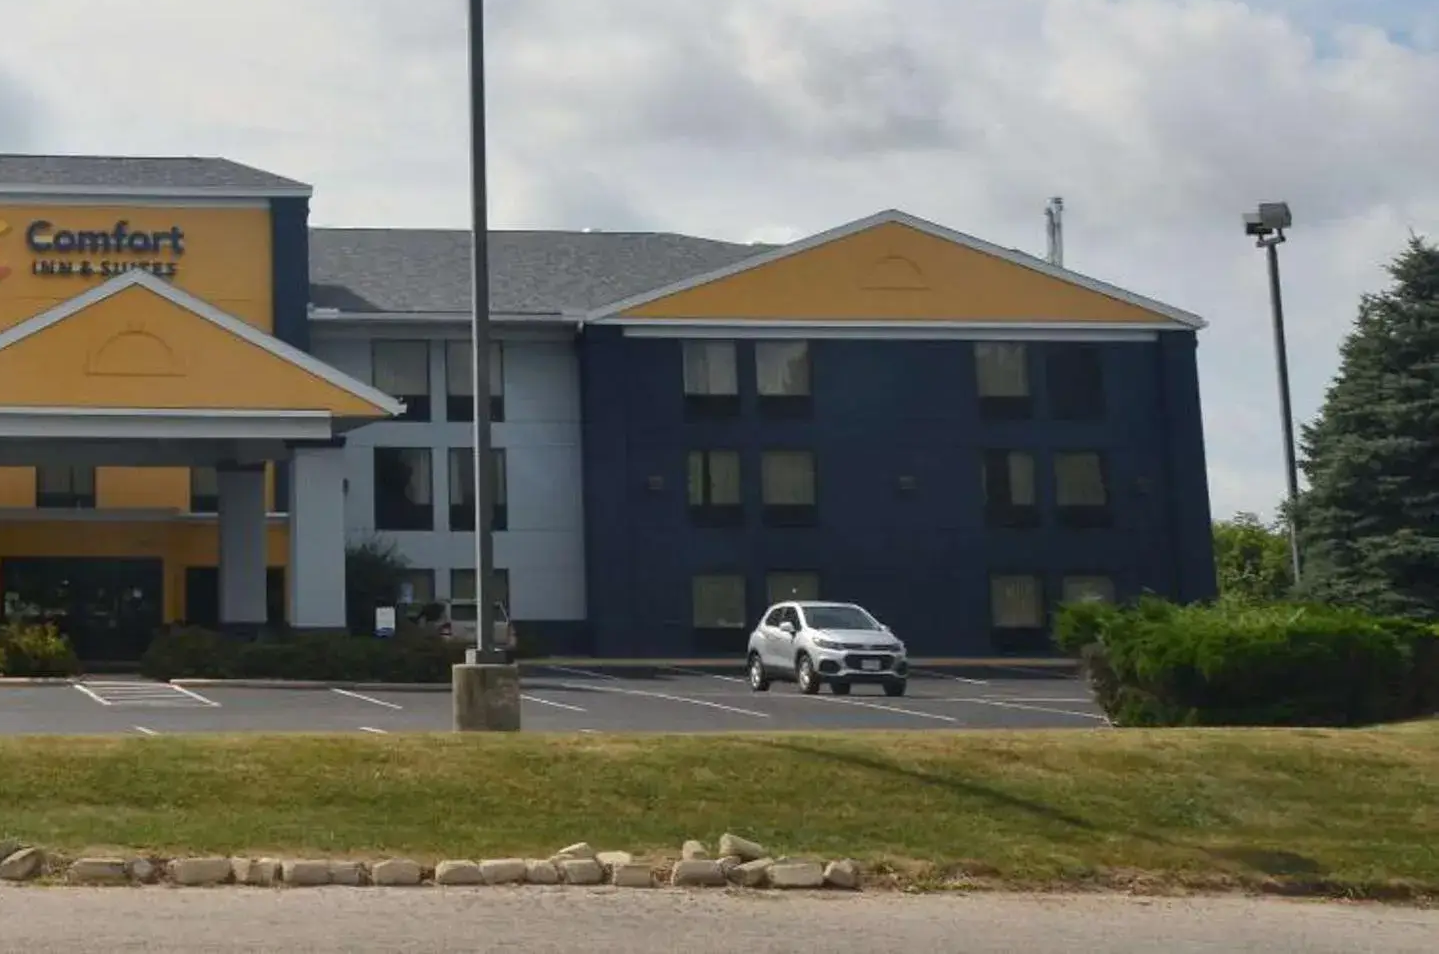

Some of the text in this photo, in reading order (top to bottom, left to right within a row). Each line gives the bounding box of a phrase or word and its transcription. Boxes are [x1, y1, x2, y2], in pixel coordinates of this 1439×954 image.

[26, 220, 184, 254] Comfort
[32, 259, 73, 275] INN
[80, 260, 94, 275] &
